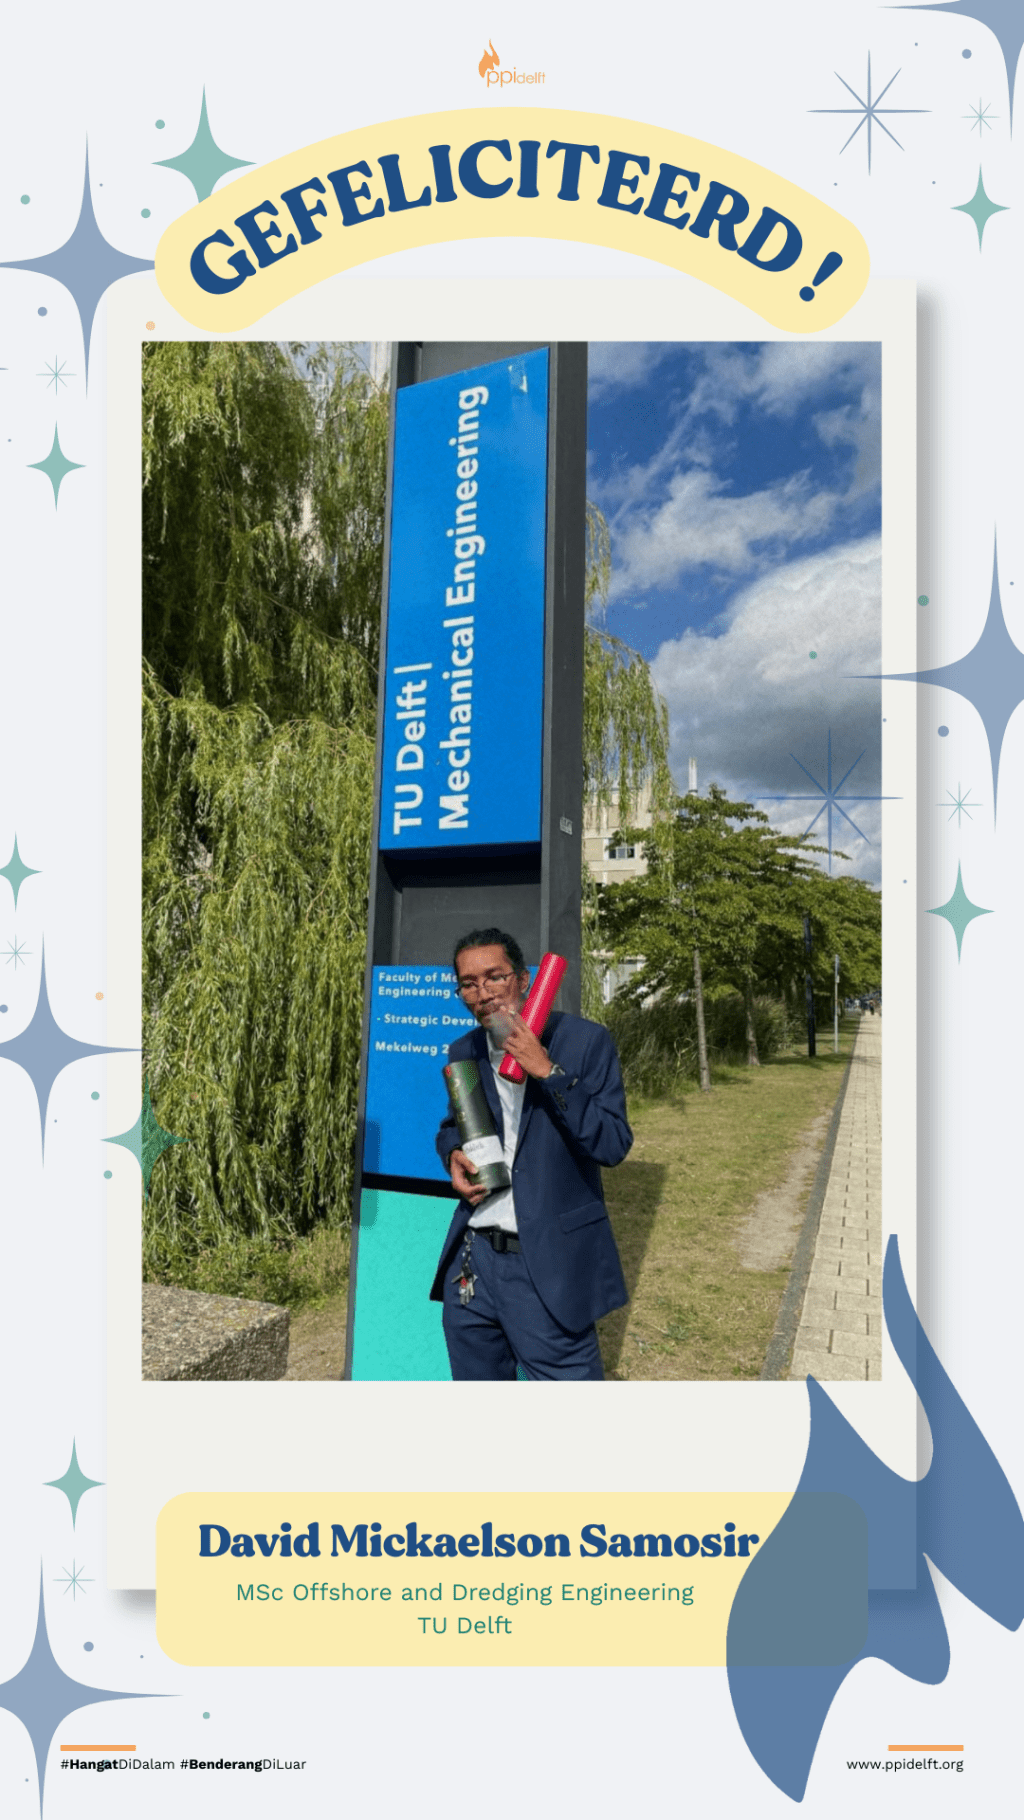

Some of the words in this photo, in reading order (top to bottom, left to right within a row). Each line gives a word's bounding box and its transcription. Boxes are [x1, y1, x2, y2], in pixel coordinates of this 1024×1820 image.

[446, 385, 489, 607] Engineering
[396, 679, 427, 772] Delft
[438, 615, 475, 830] Mechanical
[393, 783, 424, 835] TU
[378, 986, 451, 999] Engineering
[379, 972, 421, 985] Faculty
[424, 972, 437, 983] of
[384, 1013, 438, 1027] Strategic
[375, 1041, 438, 1056] Mekelweg
